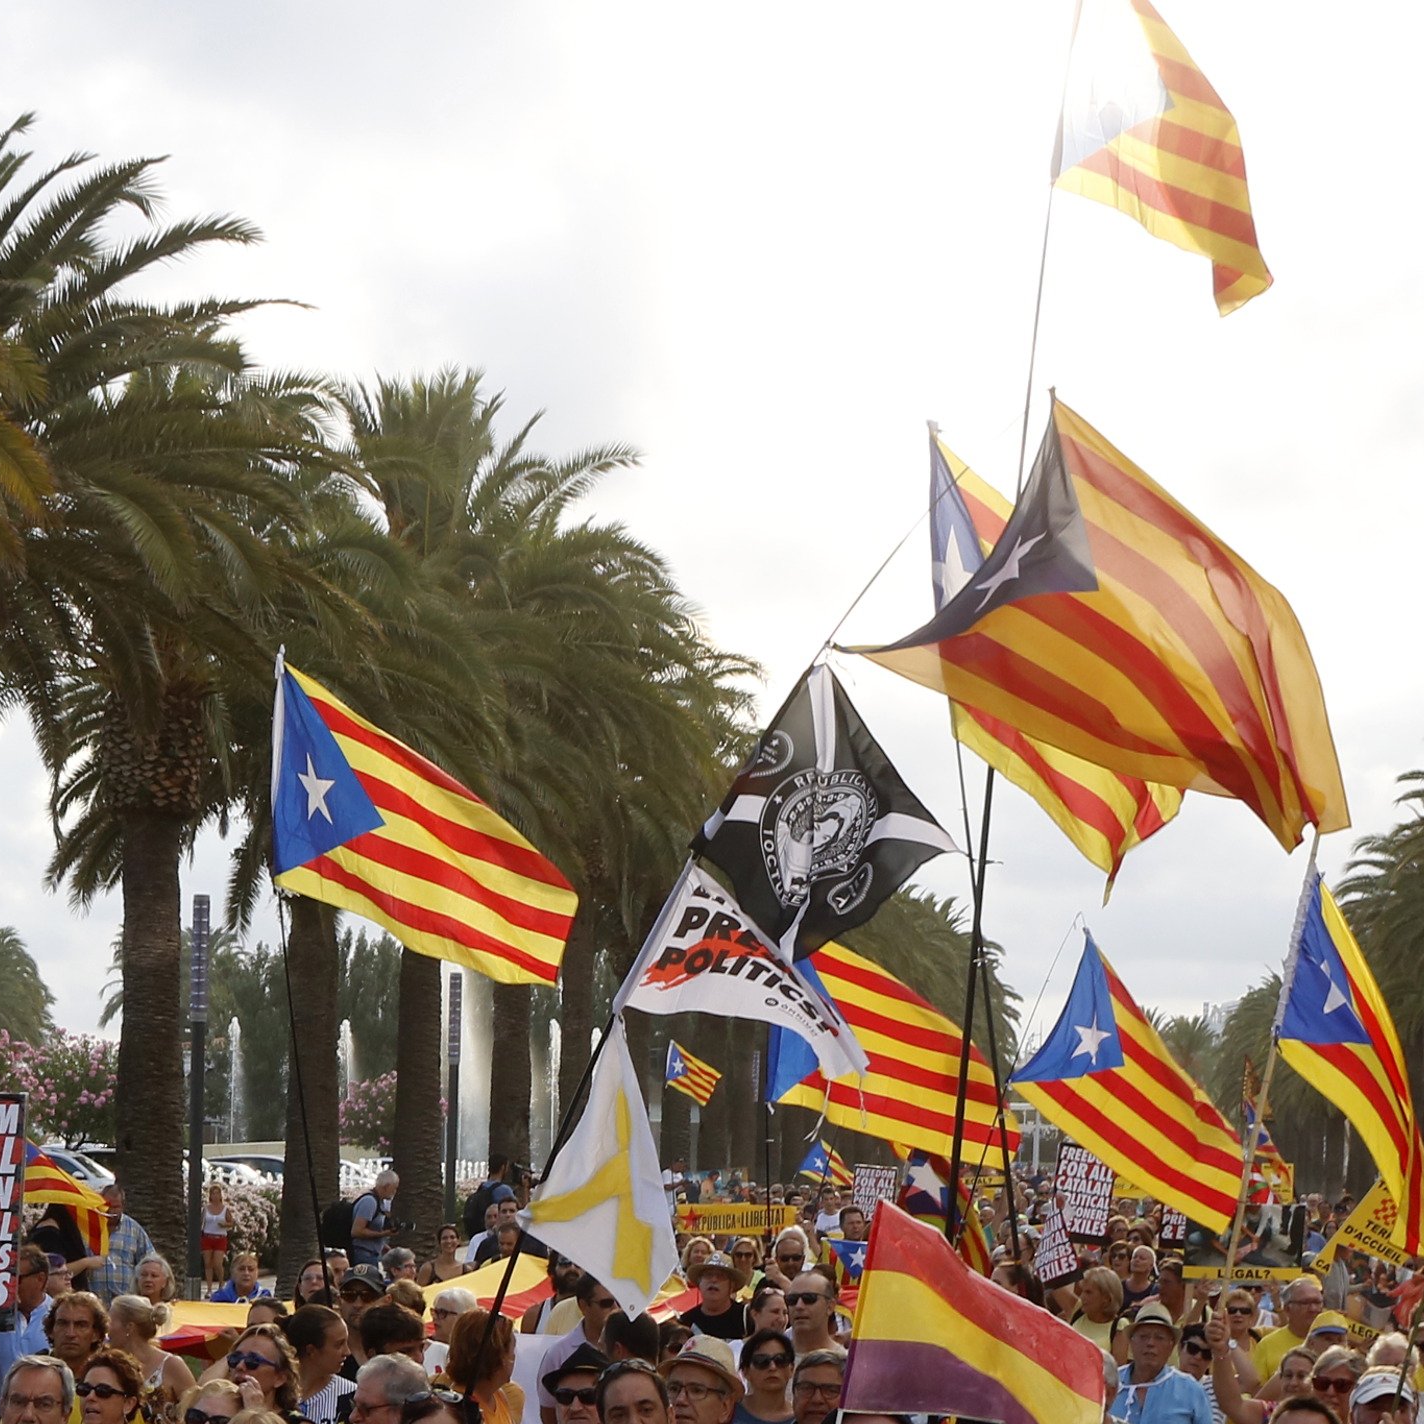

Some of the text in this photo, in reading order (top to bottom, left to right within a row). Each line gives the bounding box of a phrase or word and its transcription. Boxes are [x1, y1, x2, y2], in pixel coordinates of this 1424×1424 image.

[1060, 1146, 1103, 1165] FREED
[1058, 1159, 1114, 1182] FOR ALL
[1056, 1176, 1112, 1197] CATALAN
[1065, 1192, 1110, 1209] LITICAL
[1075, 1206, 1108, 1221] ONERS
